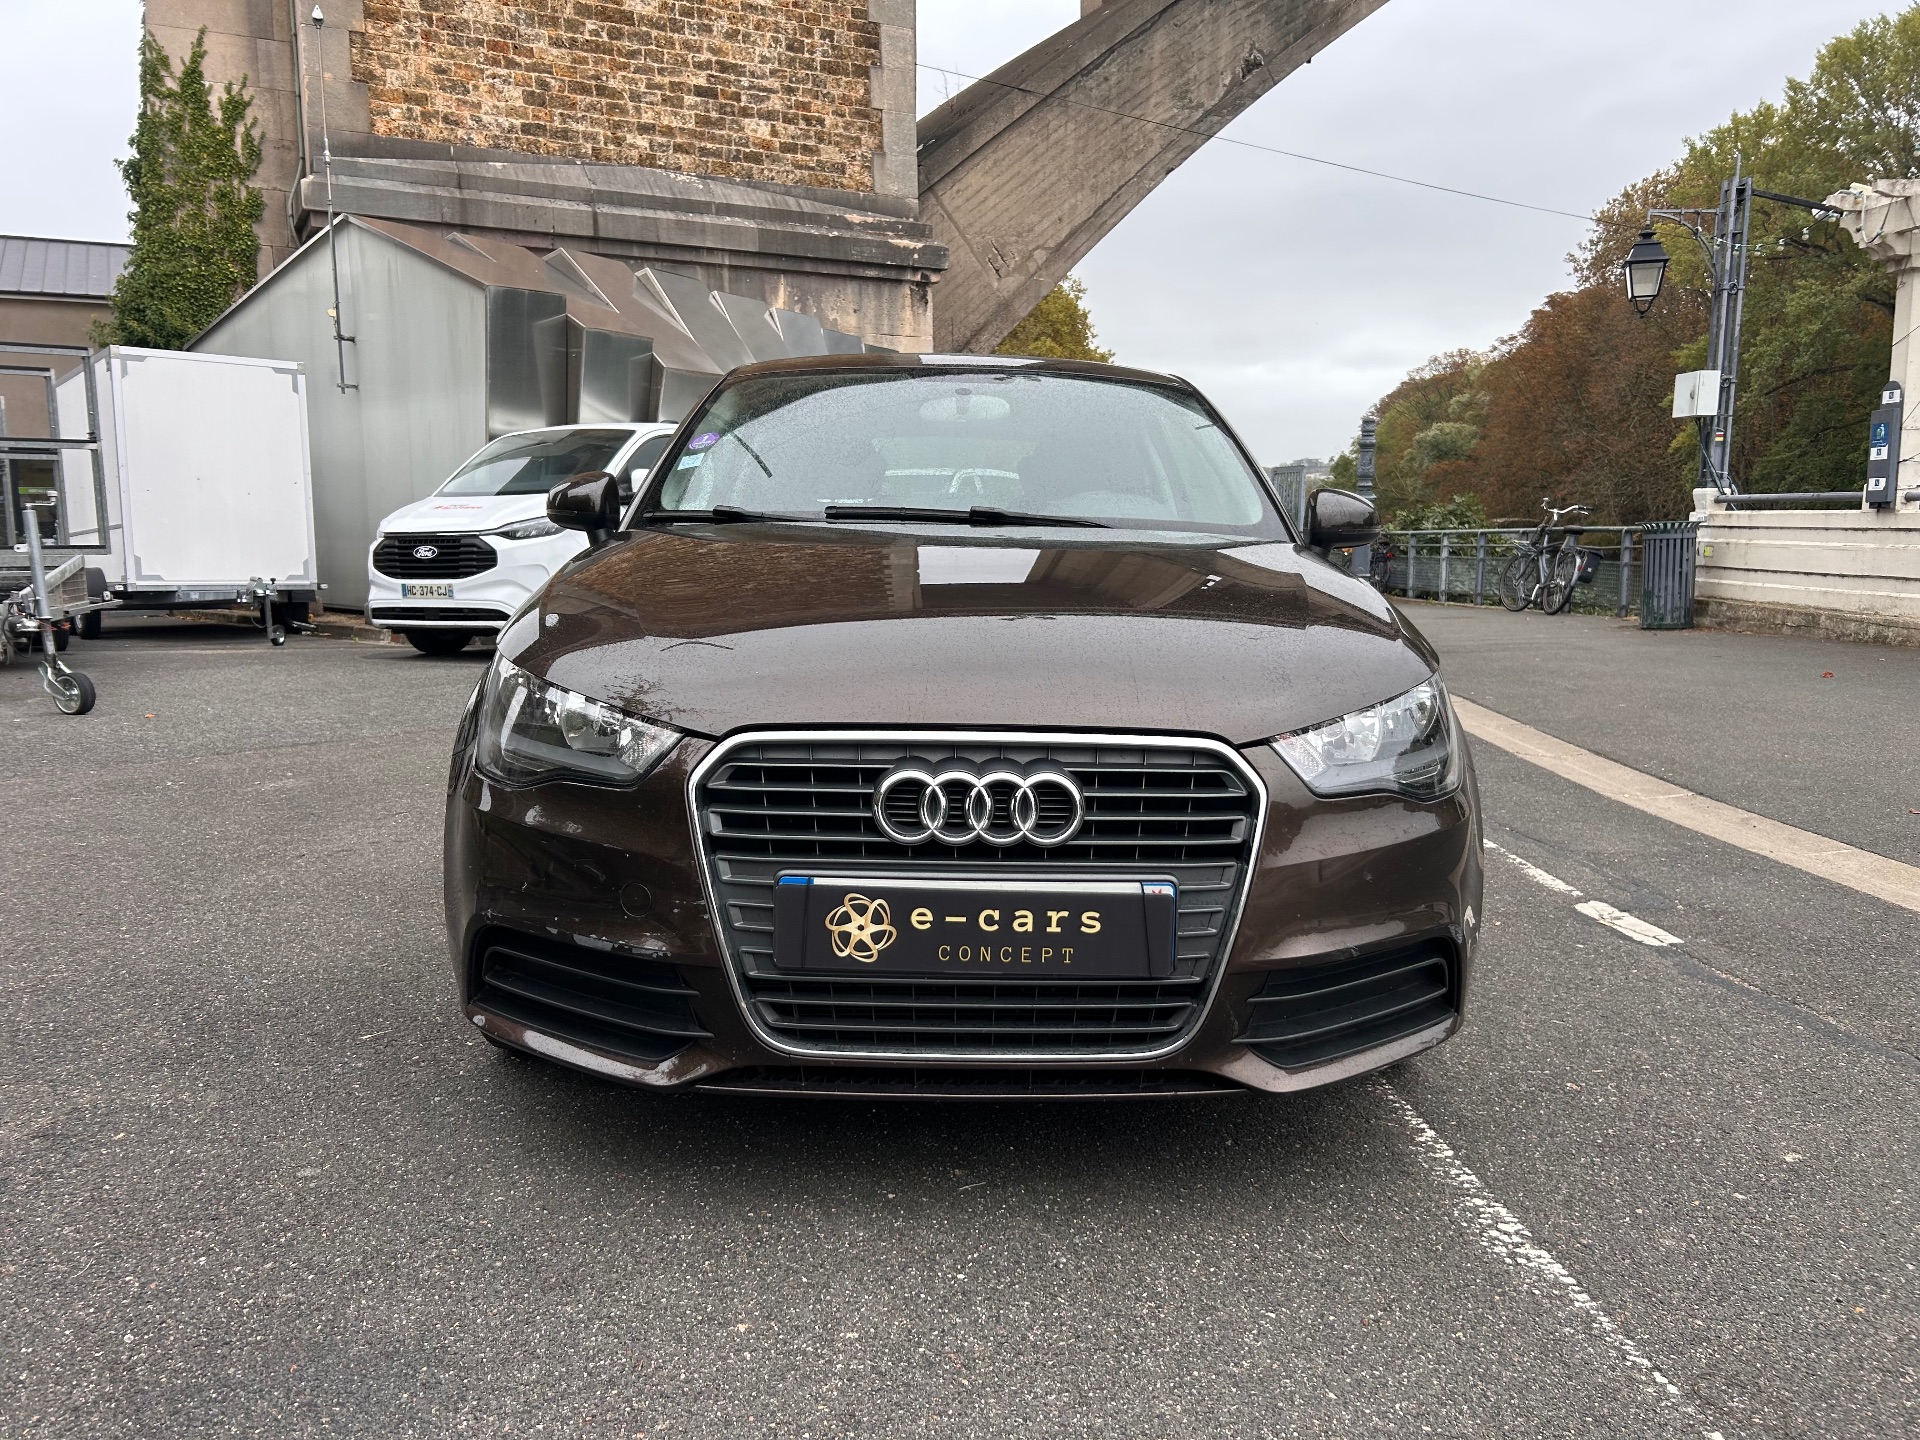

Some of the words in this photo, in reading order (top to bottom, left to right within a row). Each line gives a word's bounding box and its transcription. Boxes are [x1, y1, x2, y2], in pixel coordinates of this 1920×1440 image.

[416, 546, 434, 558] Ford
[406, 585, 448, 597] HC-374-CJ
[910, 906, 1102, 933] e-cars
[938, 945, 1075, 963] CONCEPT
